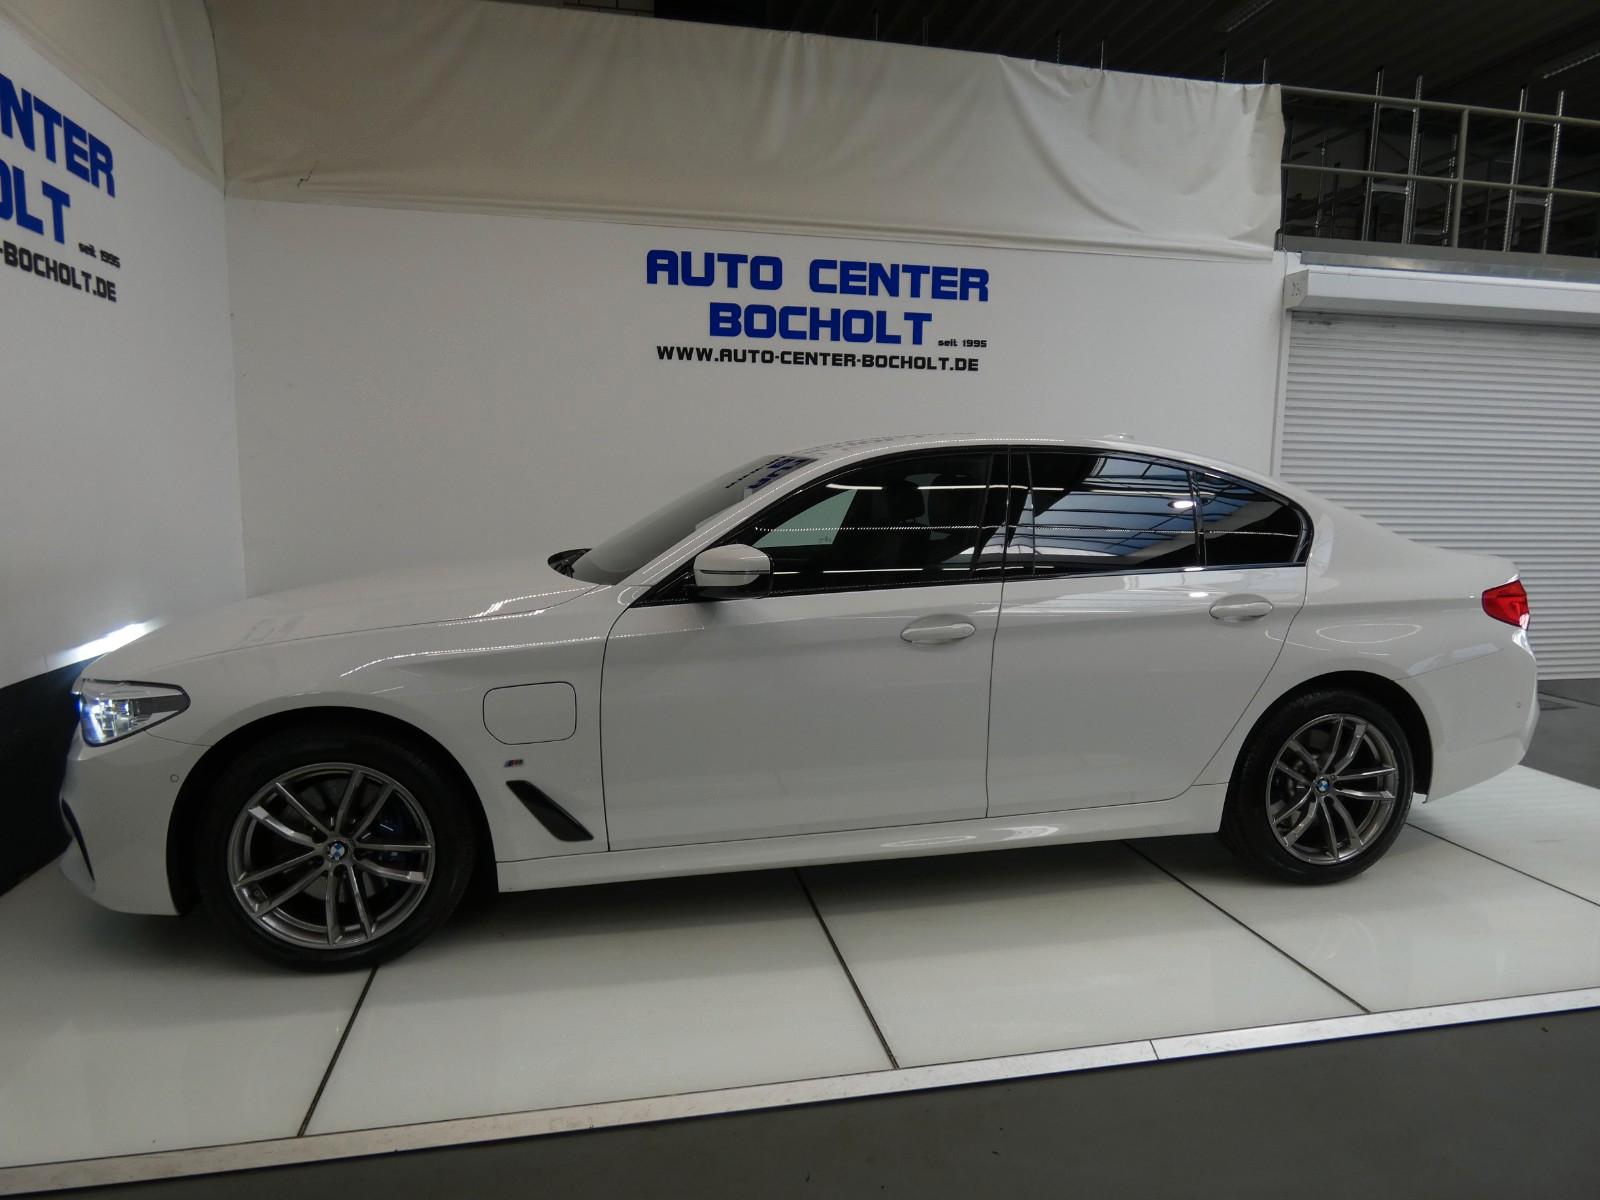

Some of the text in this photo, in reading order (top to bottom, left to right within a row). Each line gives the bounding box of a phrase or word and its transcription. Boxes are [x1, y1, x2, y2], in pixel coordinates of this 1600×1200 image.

[647, 249, 990, 303] AUTO CENTER
[709, 302, 988, 348] BOCHOLT seit 1995
[656, 345, 979, 372] WWW.AUTO-CENTER-BOCHOLT.DE
